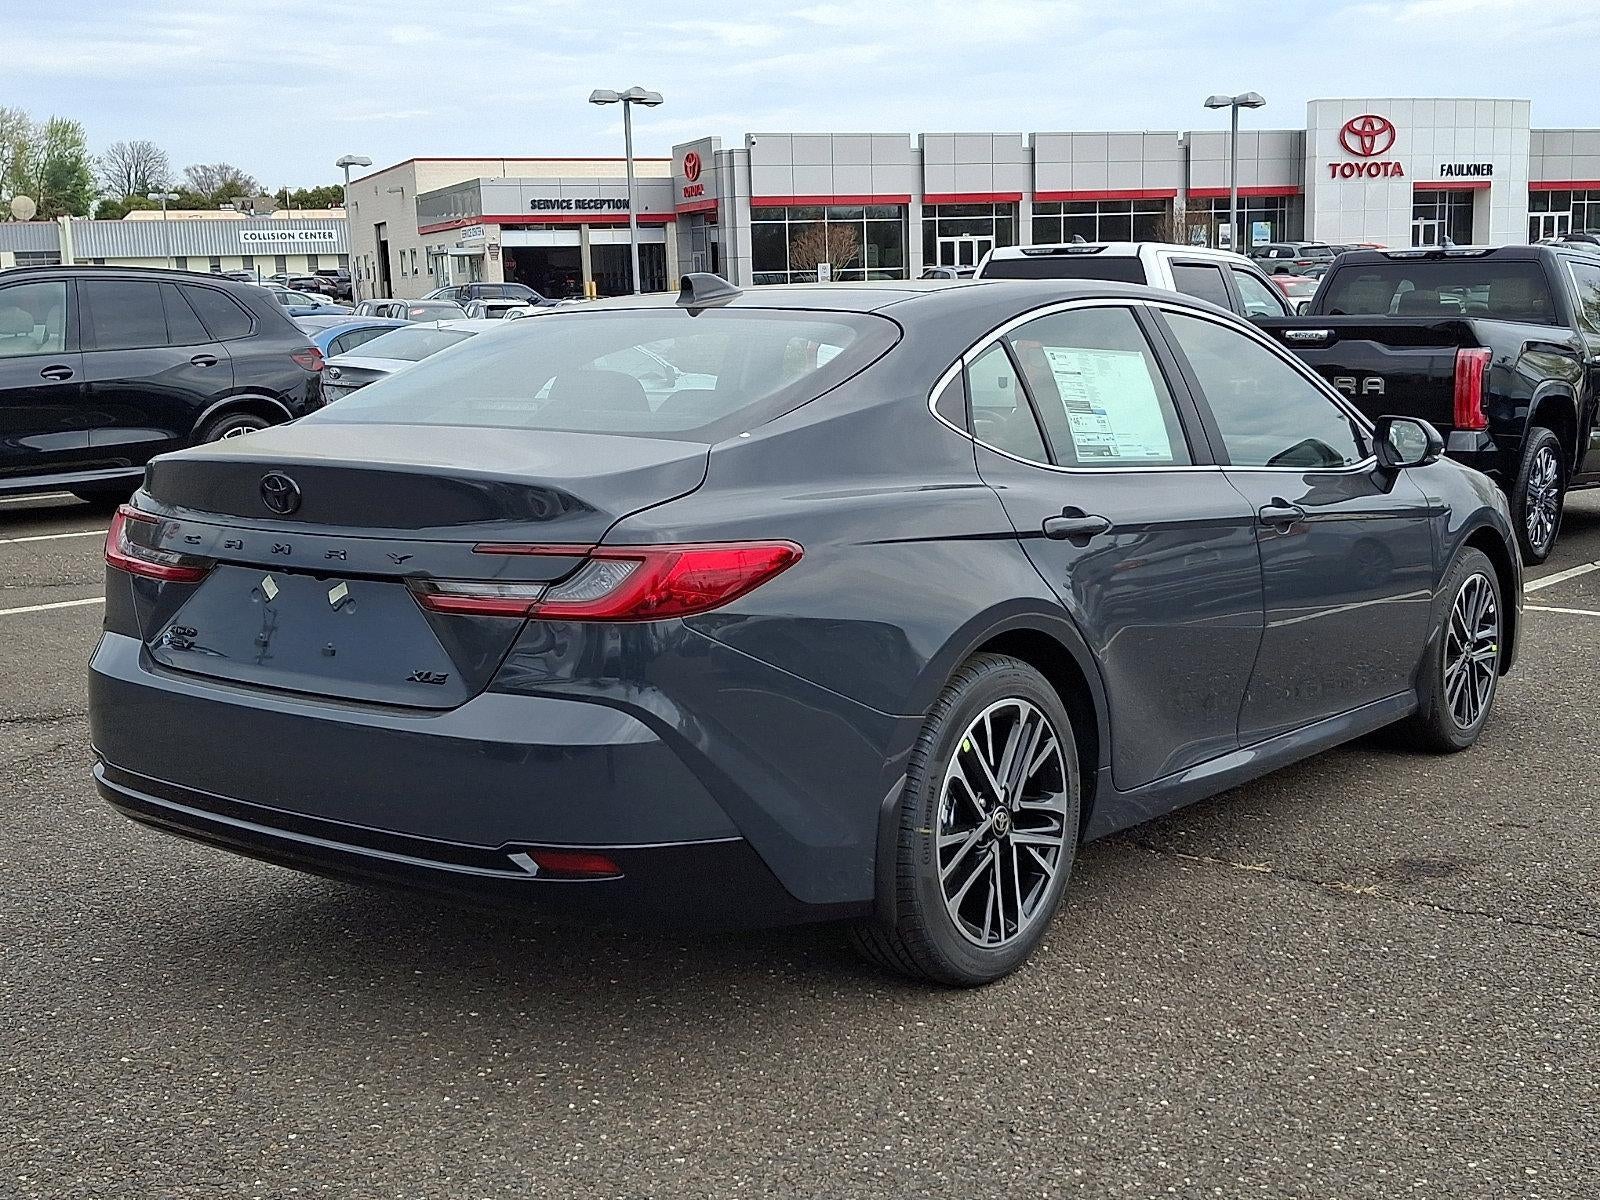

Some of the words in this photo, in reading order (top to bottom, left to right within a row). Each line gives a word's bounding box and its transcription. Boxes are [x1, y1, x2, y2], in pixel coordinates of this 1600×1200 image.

[1328, 161, 1405, 179] TOYOTA
[1440, 163, 1493, 177] FAULKNER
[530, 198, 573, 210] SERVICE
[574, 198, 630, 210] RECEPTION
[243, 232, 296, 241] COLLISION
[298, 231, 335, 240] CENTER
[183, 534, 414, 566] CAMRY
[404, 669, 449, 686] XLE
